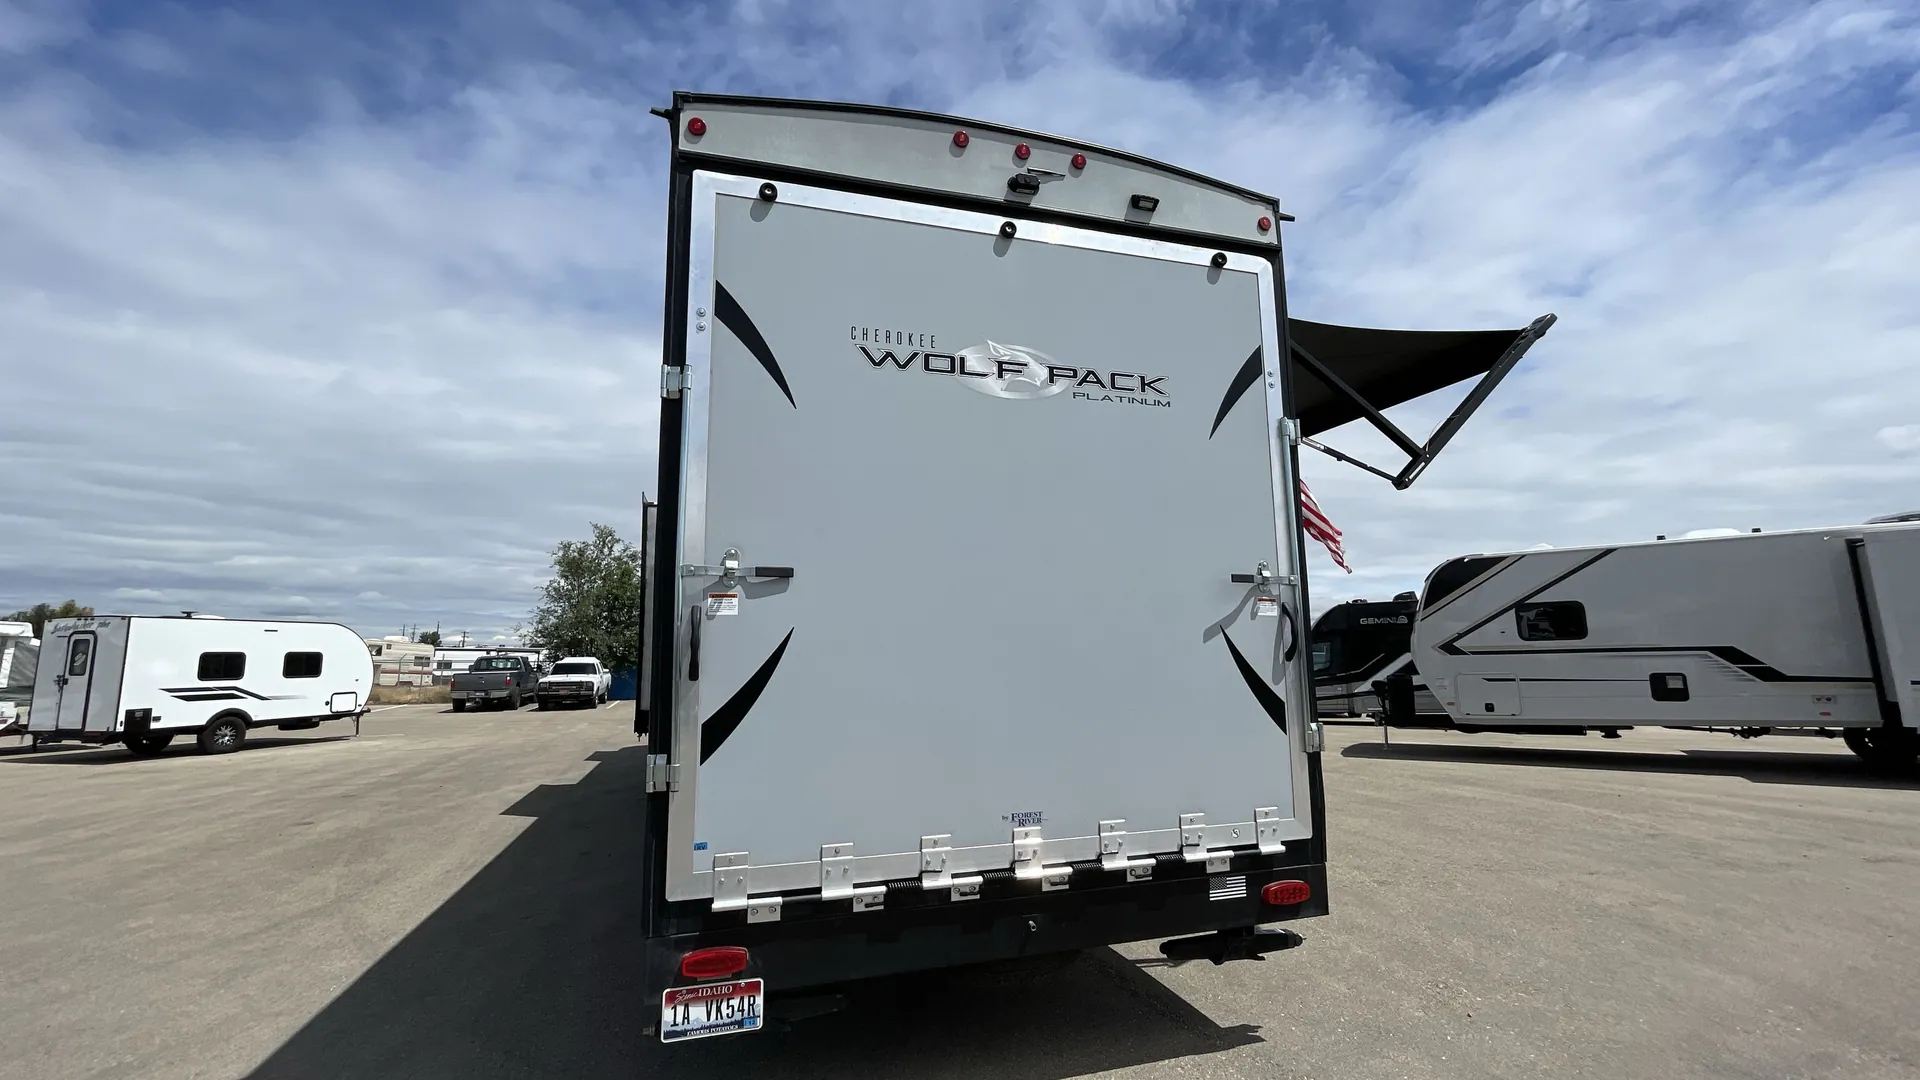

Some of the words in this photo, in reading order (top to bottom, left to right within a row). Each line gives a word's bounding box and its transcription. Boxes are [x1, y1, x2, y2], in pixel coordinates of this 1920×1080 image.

[850, 325, 937, 349] CHEROKEE
[854, 343, 1031, 381] WOLF
[1039, 362, 1171, 397] PACK
[1072, 391, 1171, 408] PLATINUM
[1011, 811, 1042, 822] FOREST
[1018, 817, 1043, 827] RIVER
[698, 985, 733, 997] IDAHO
[670, 1003, 690, 1027] 1A
[705, 994, 757, 1022] VK54R
